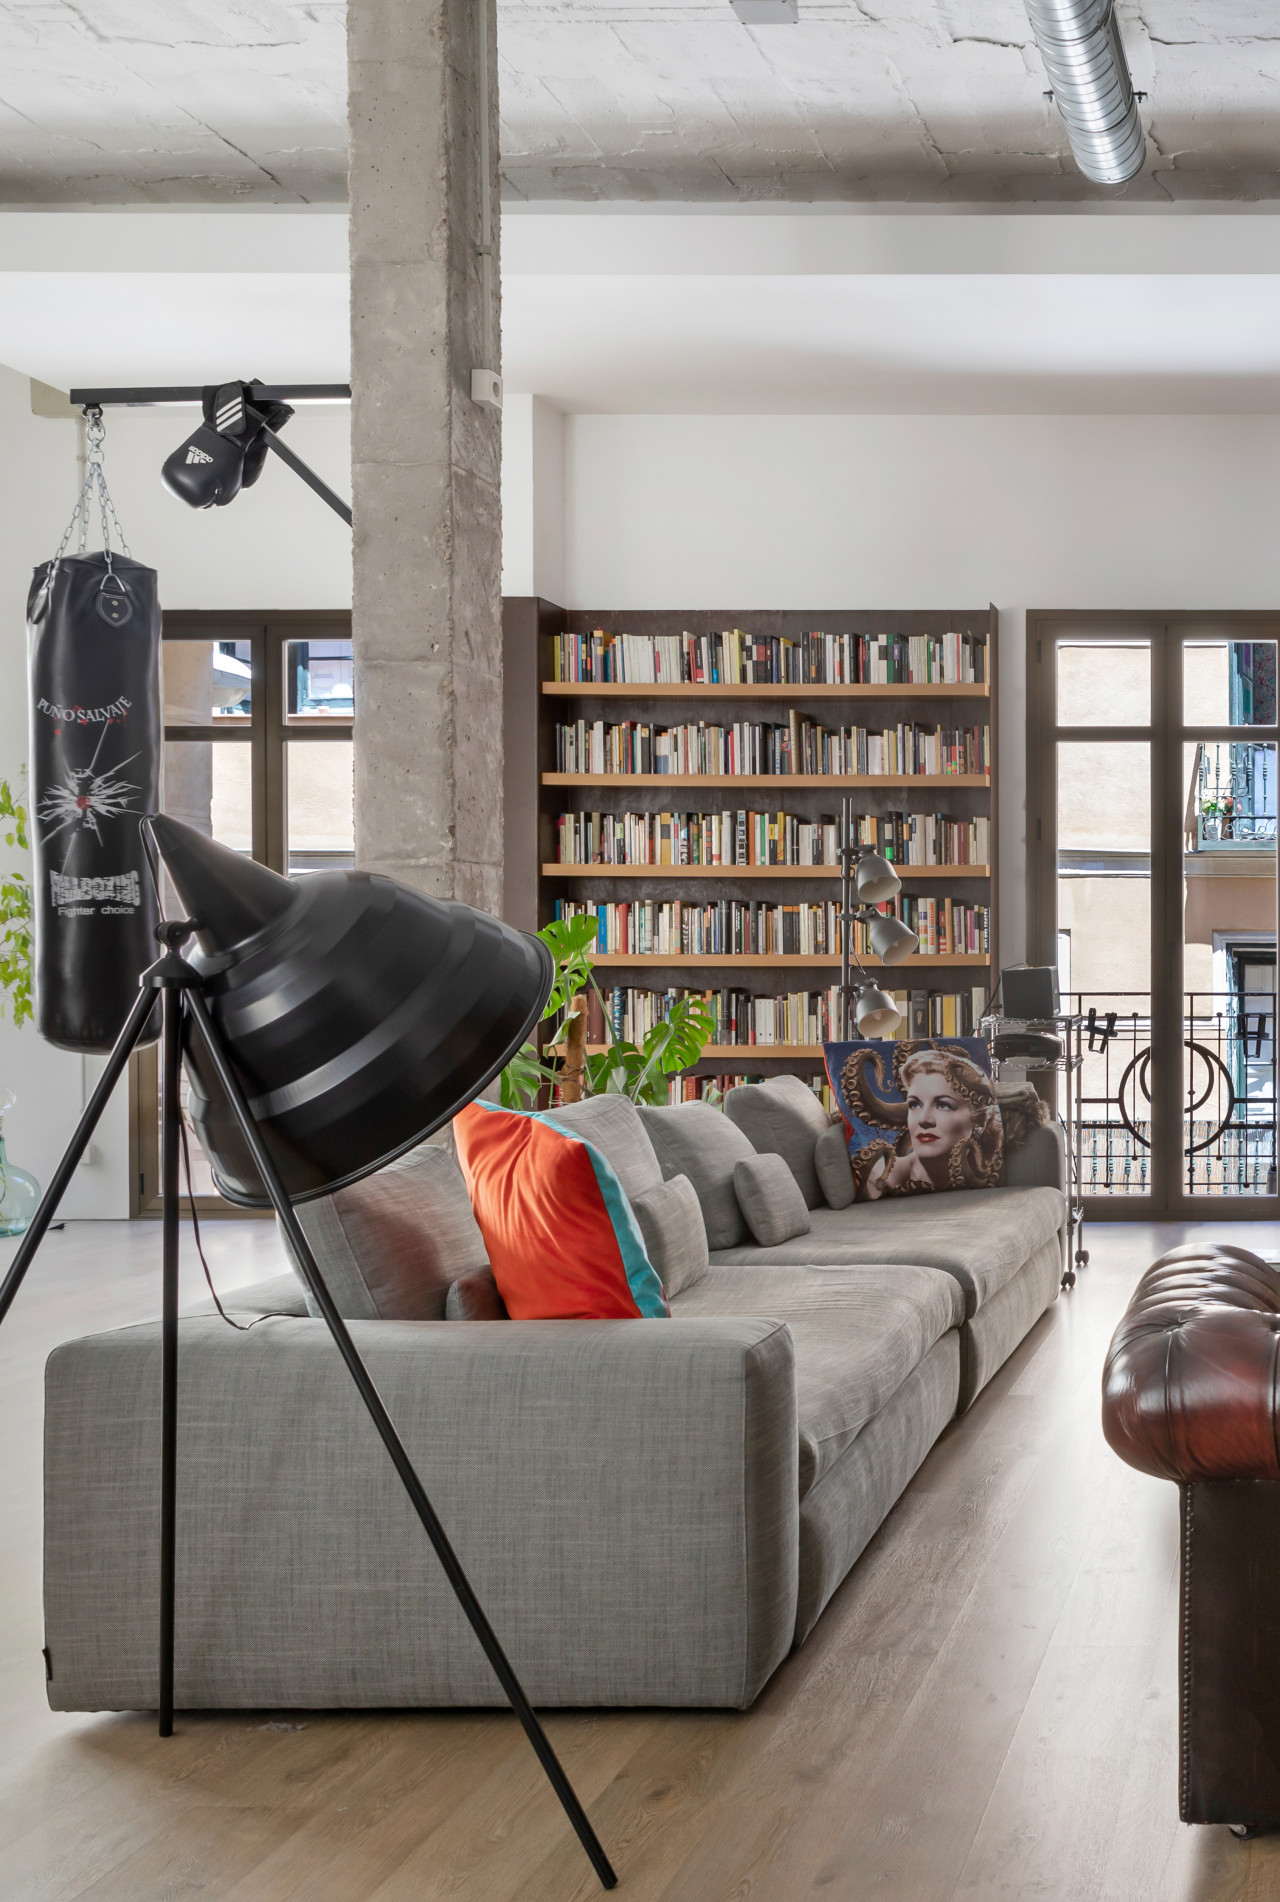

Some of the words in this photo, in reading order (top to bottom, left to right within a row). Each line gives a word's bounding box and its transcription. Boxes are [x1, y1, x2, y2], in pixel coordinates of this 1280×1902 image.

[188, 445, 214, 463] adidas
[36, 697, 76, 722] PUÑO
[76, 696, 132, 723] SALVAJE
[58, 906, 96, 918] Fighter
[101, 905, 136, 915] choice
